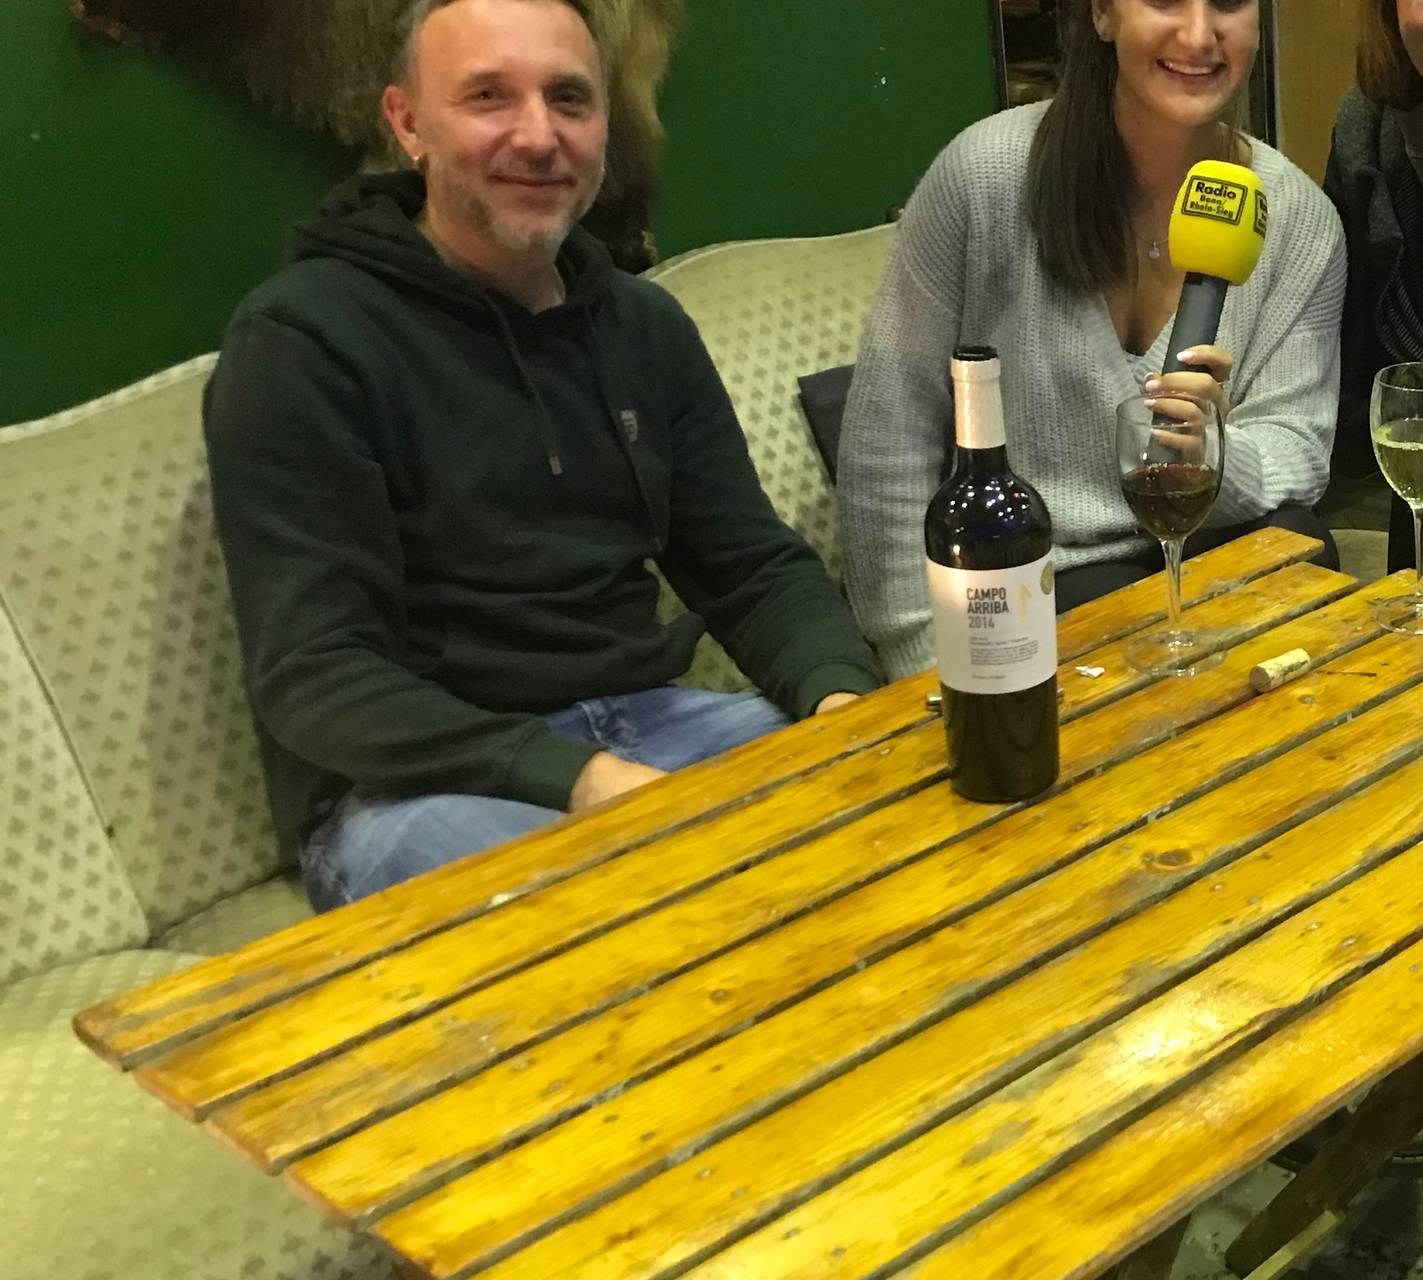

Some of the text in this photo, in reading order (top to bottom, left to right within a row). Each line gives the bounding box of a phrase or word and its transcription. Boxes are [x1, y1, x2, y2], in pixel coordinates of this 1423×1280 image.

[1195, 181, 1237, 200] Radio
[1190, 201, 1234, 219] Rhein-Sieg
[966, 587, 1007, 601] CAMPO
[967, 601, 1010, 615] ARRIBA
[968, 615, 995, 629] 2014
